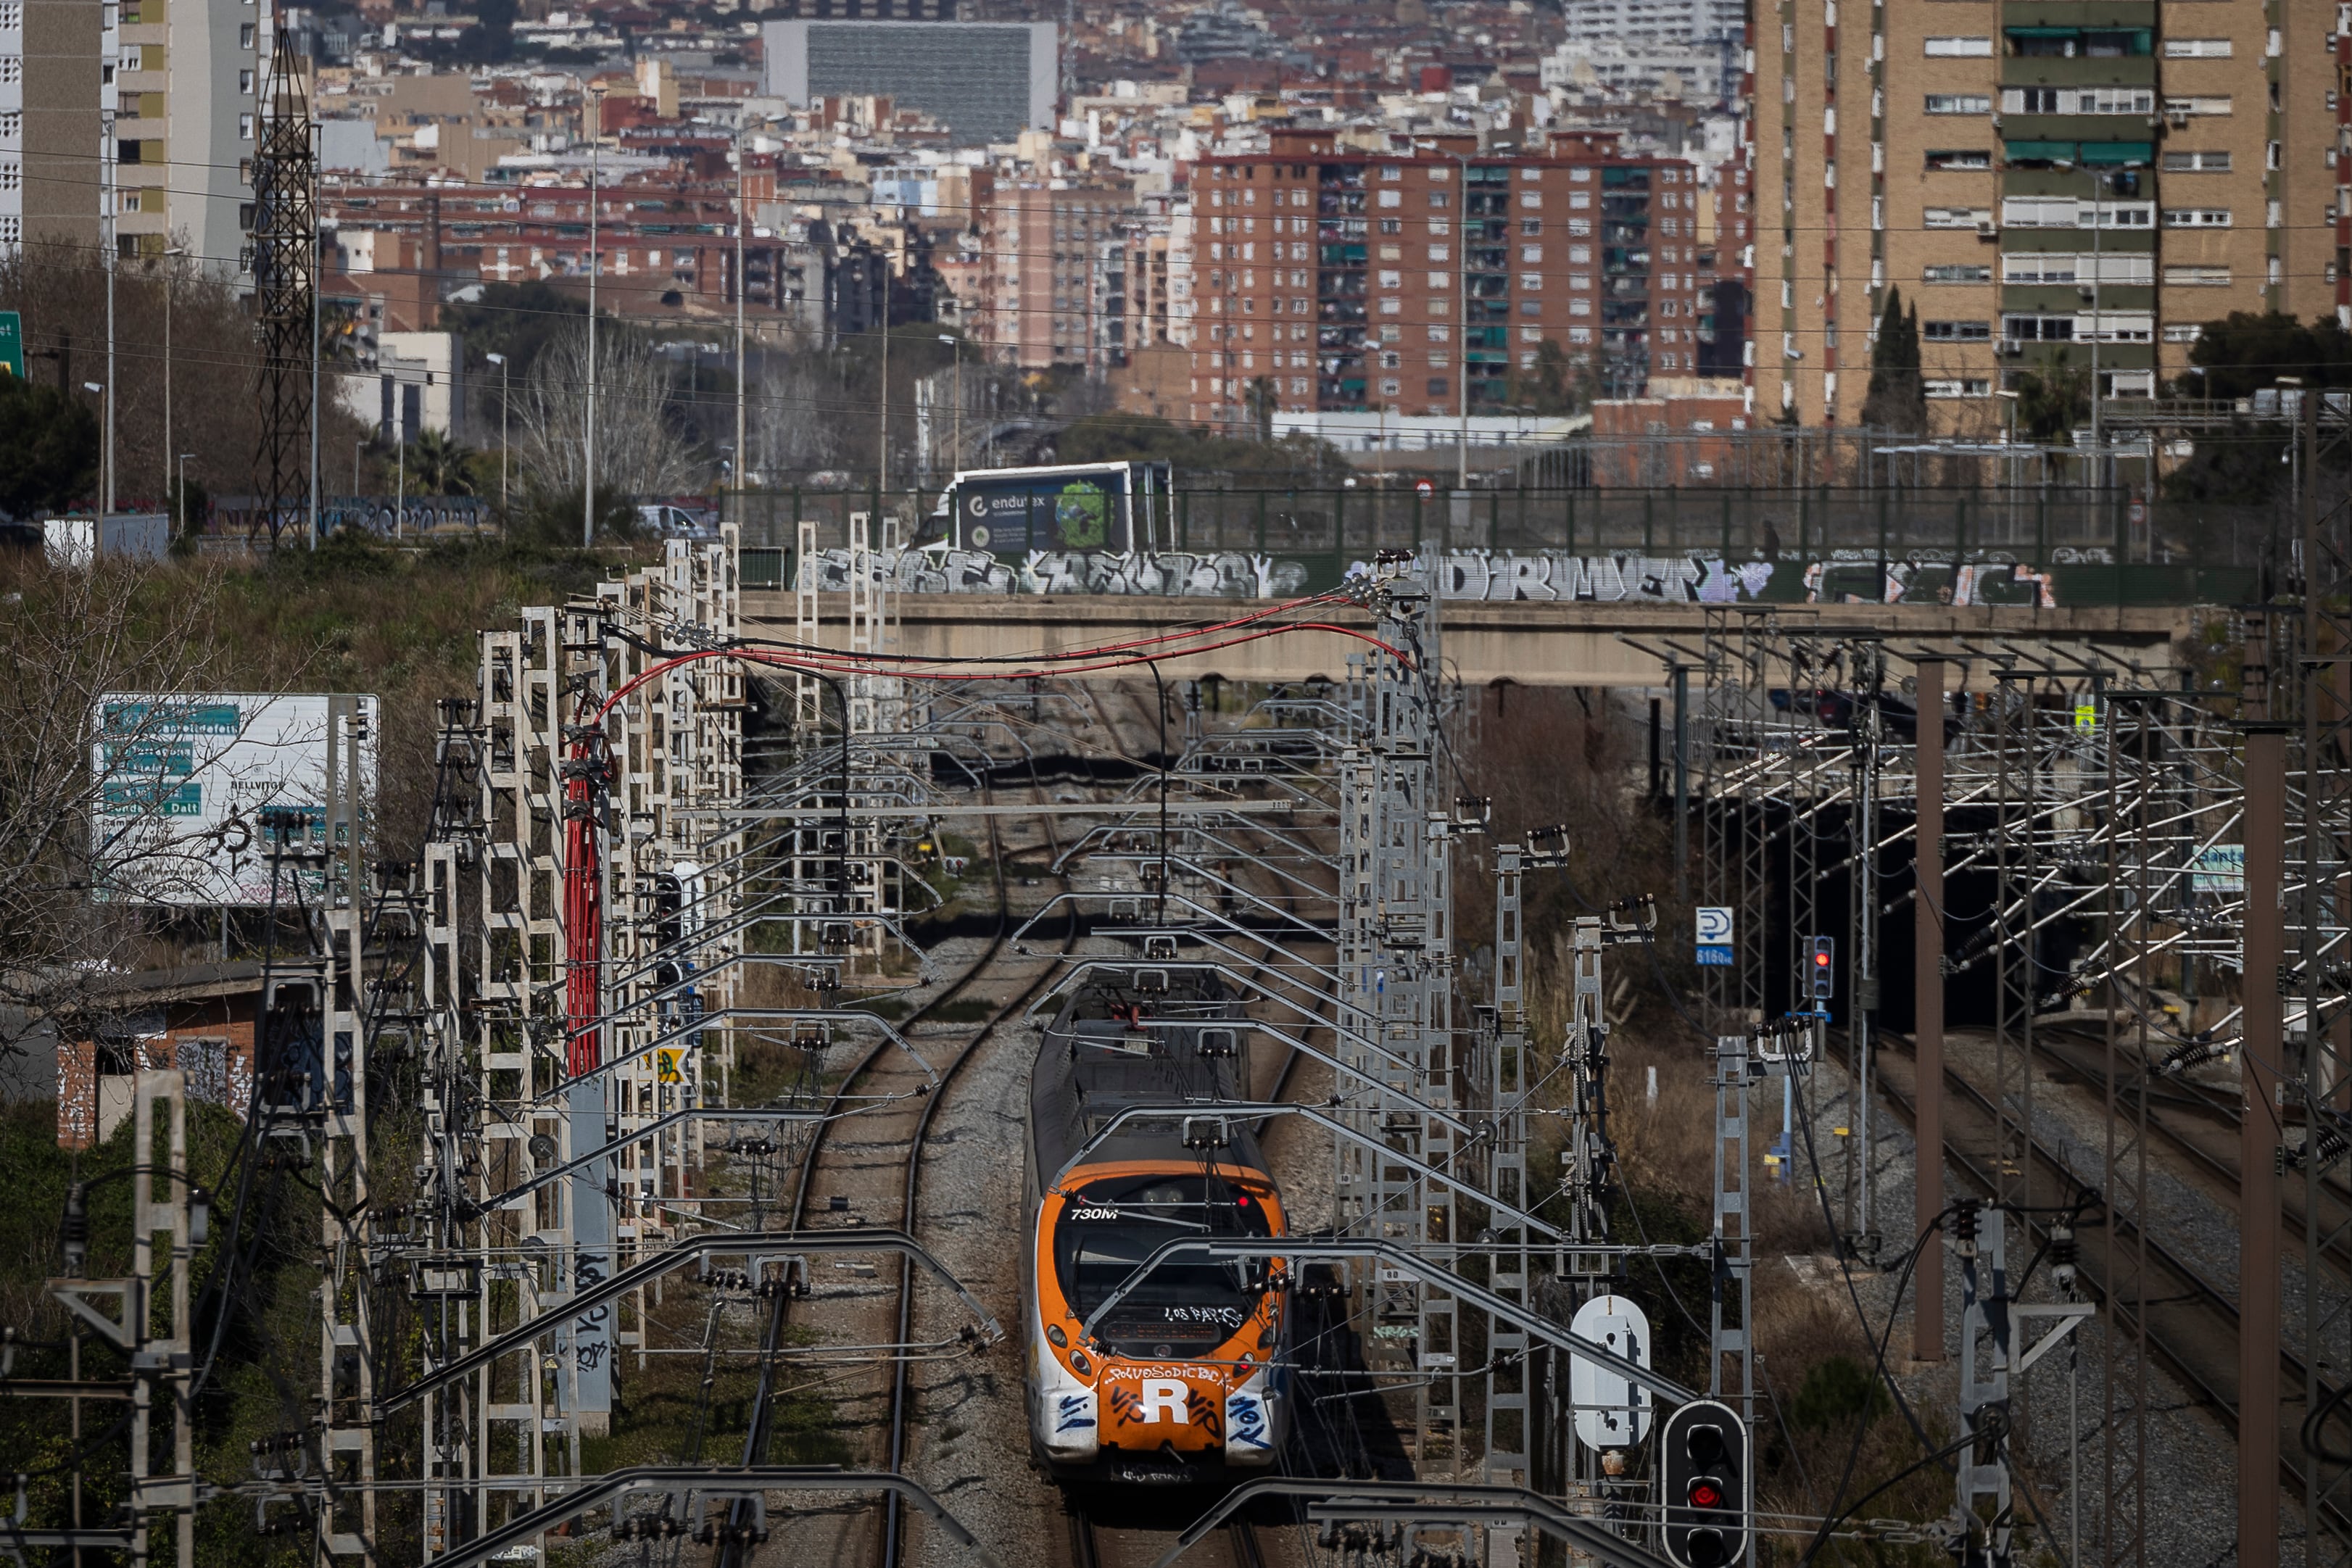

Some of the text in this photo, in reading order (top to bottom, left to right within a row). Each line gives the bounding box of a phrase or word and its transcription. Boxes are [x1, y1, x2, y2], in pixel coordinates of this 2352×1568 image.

[172, 803, 197, 813] Dalt
[1072, 1208, 1117, 1220] 730M
[1142, 1379, 1190, 1424] R
